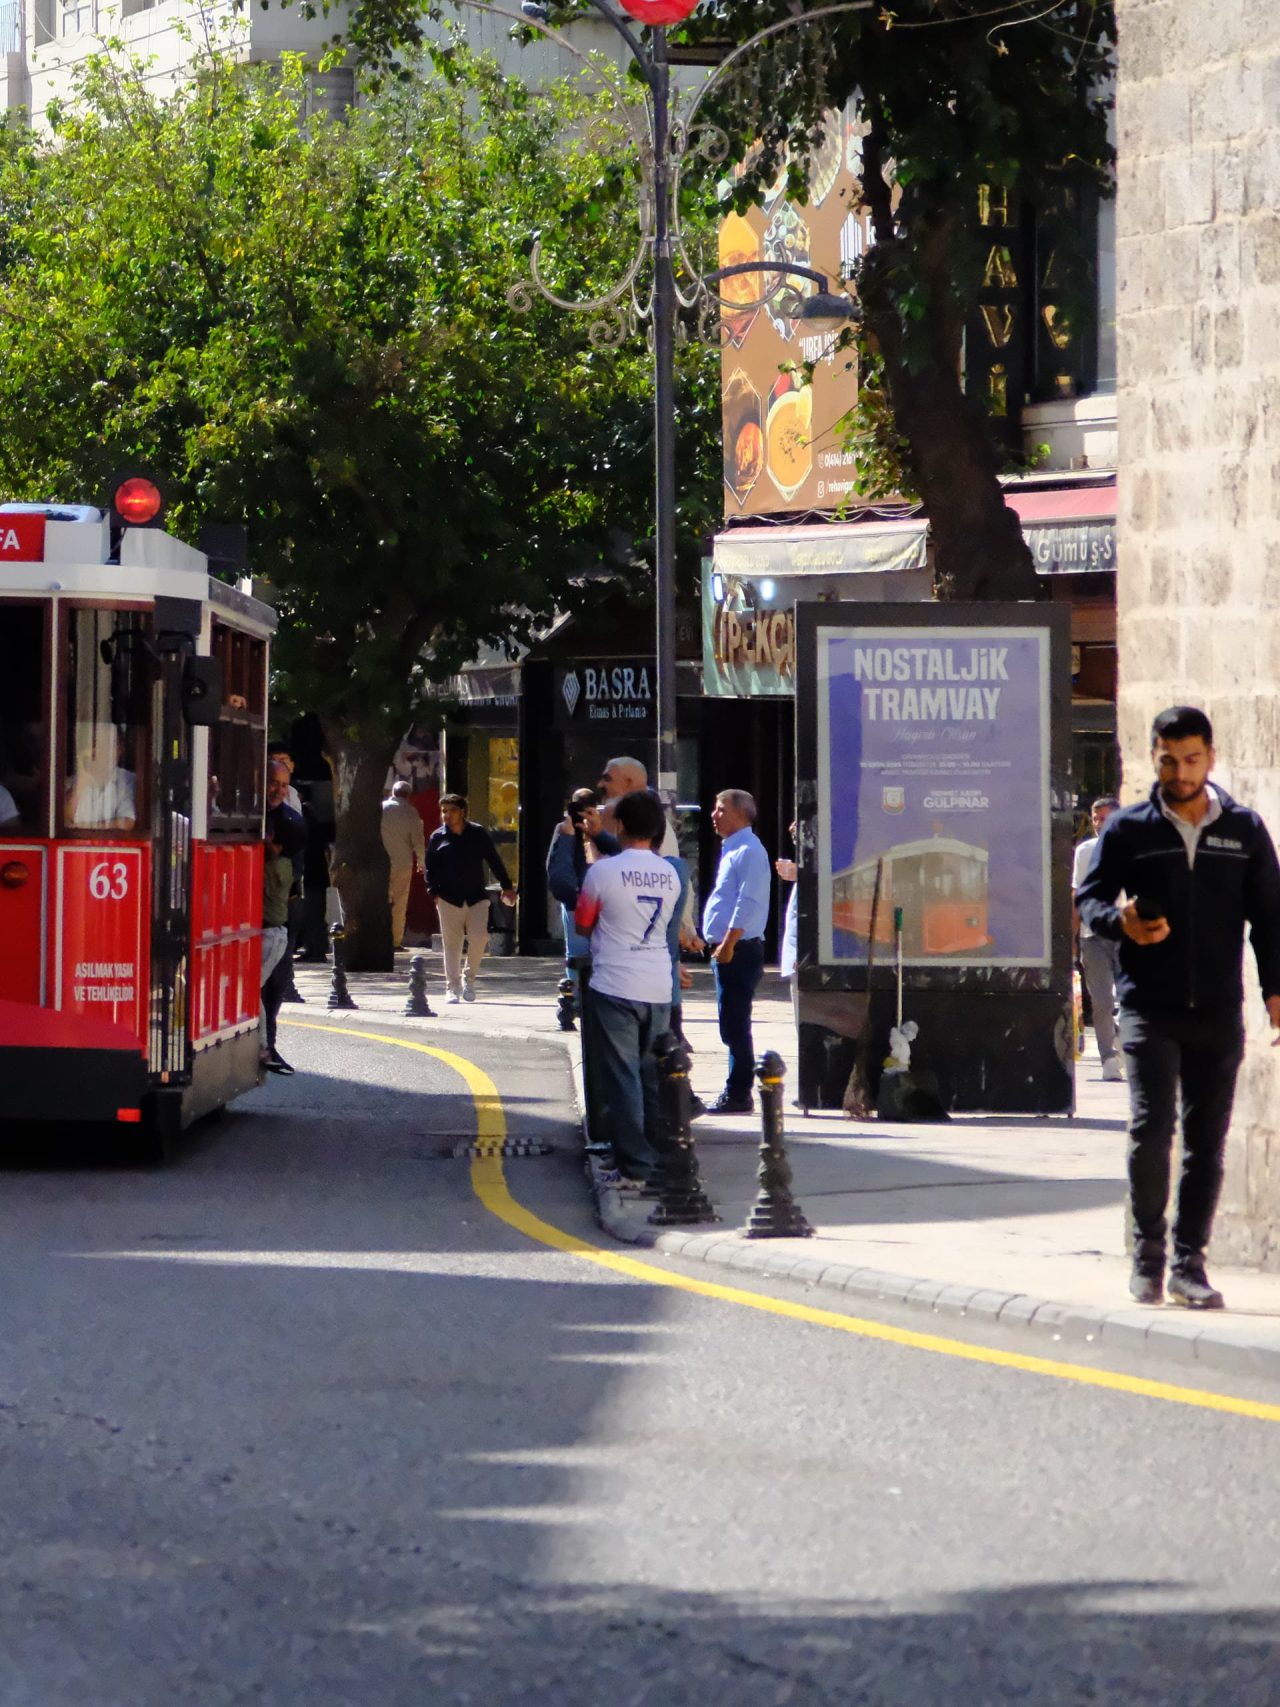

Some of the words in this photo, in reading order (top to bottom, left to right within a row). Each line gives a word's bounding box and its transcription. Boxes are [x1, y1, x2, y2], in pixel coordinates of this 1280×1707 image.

[585, 667, 651, 700] BASRA
[864, 688, 1000, 720] TRAMVAY
[89, 862, 128, 899] 63
[637, 895, 664, 944] 7
[75, 962, 114, 978] ASILMAK
[74, 986, 86, 1001] VE
